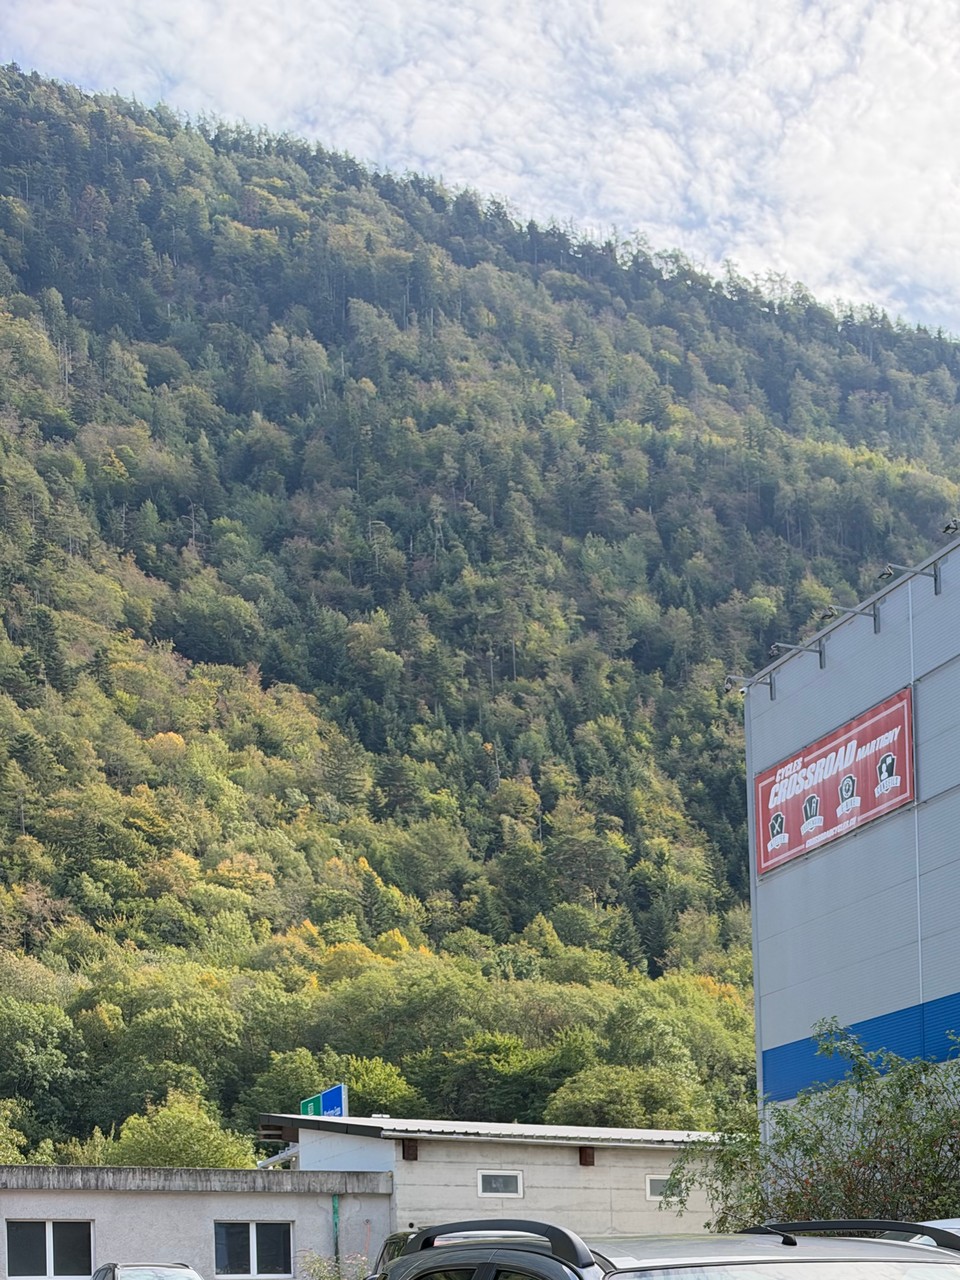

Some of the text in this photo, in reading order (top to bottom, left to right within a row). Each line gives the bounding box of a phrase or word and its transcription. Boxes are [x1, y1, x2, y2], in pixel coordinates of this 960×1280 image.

[769, 725, 901, 809] CROSSROAD MARTIGNY
[775, 757, 803, 783] CYCLES
